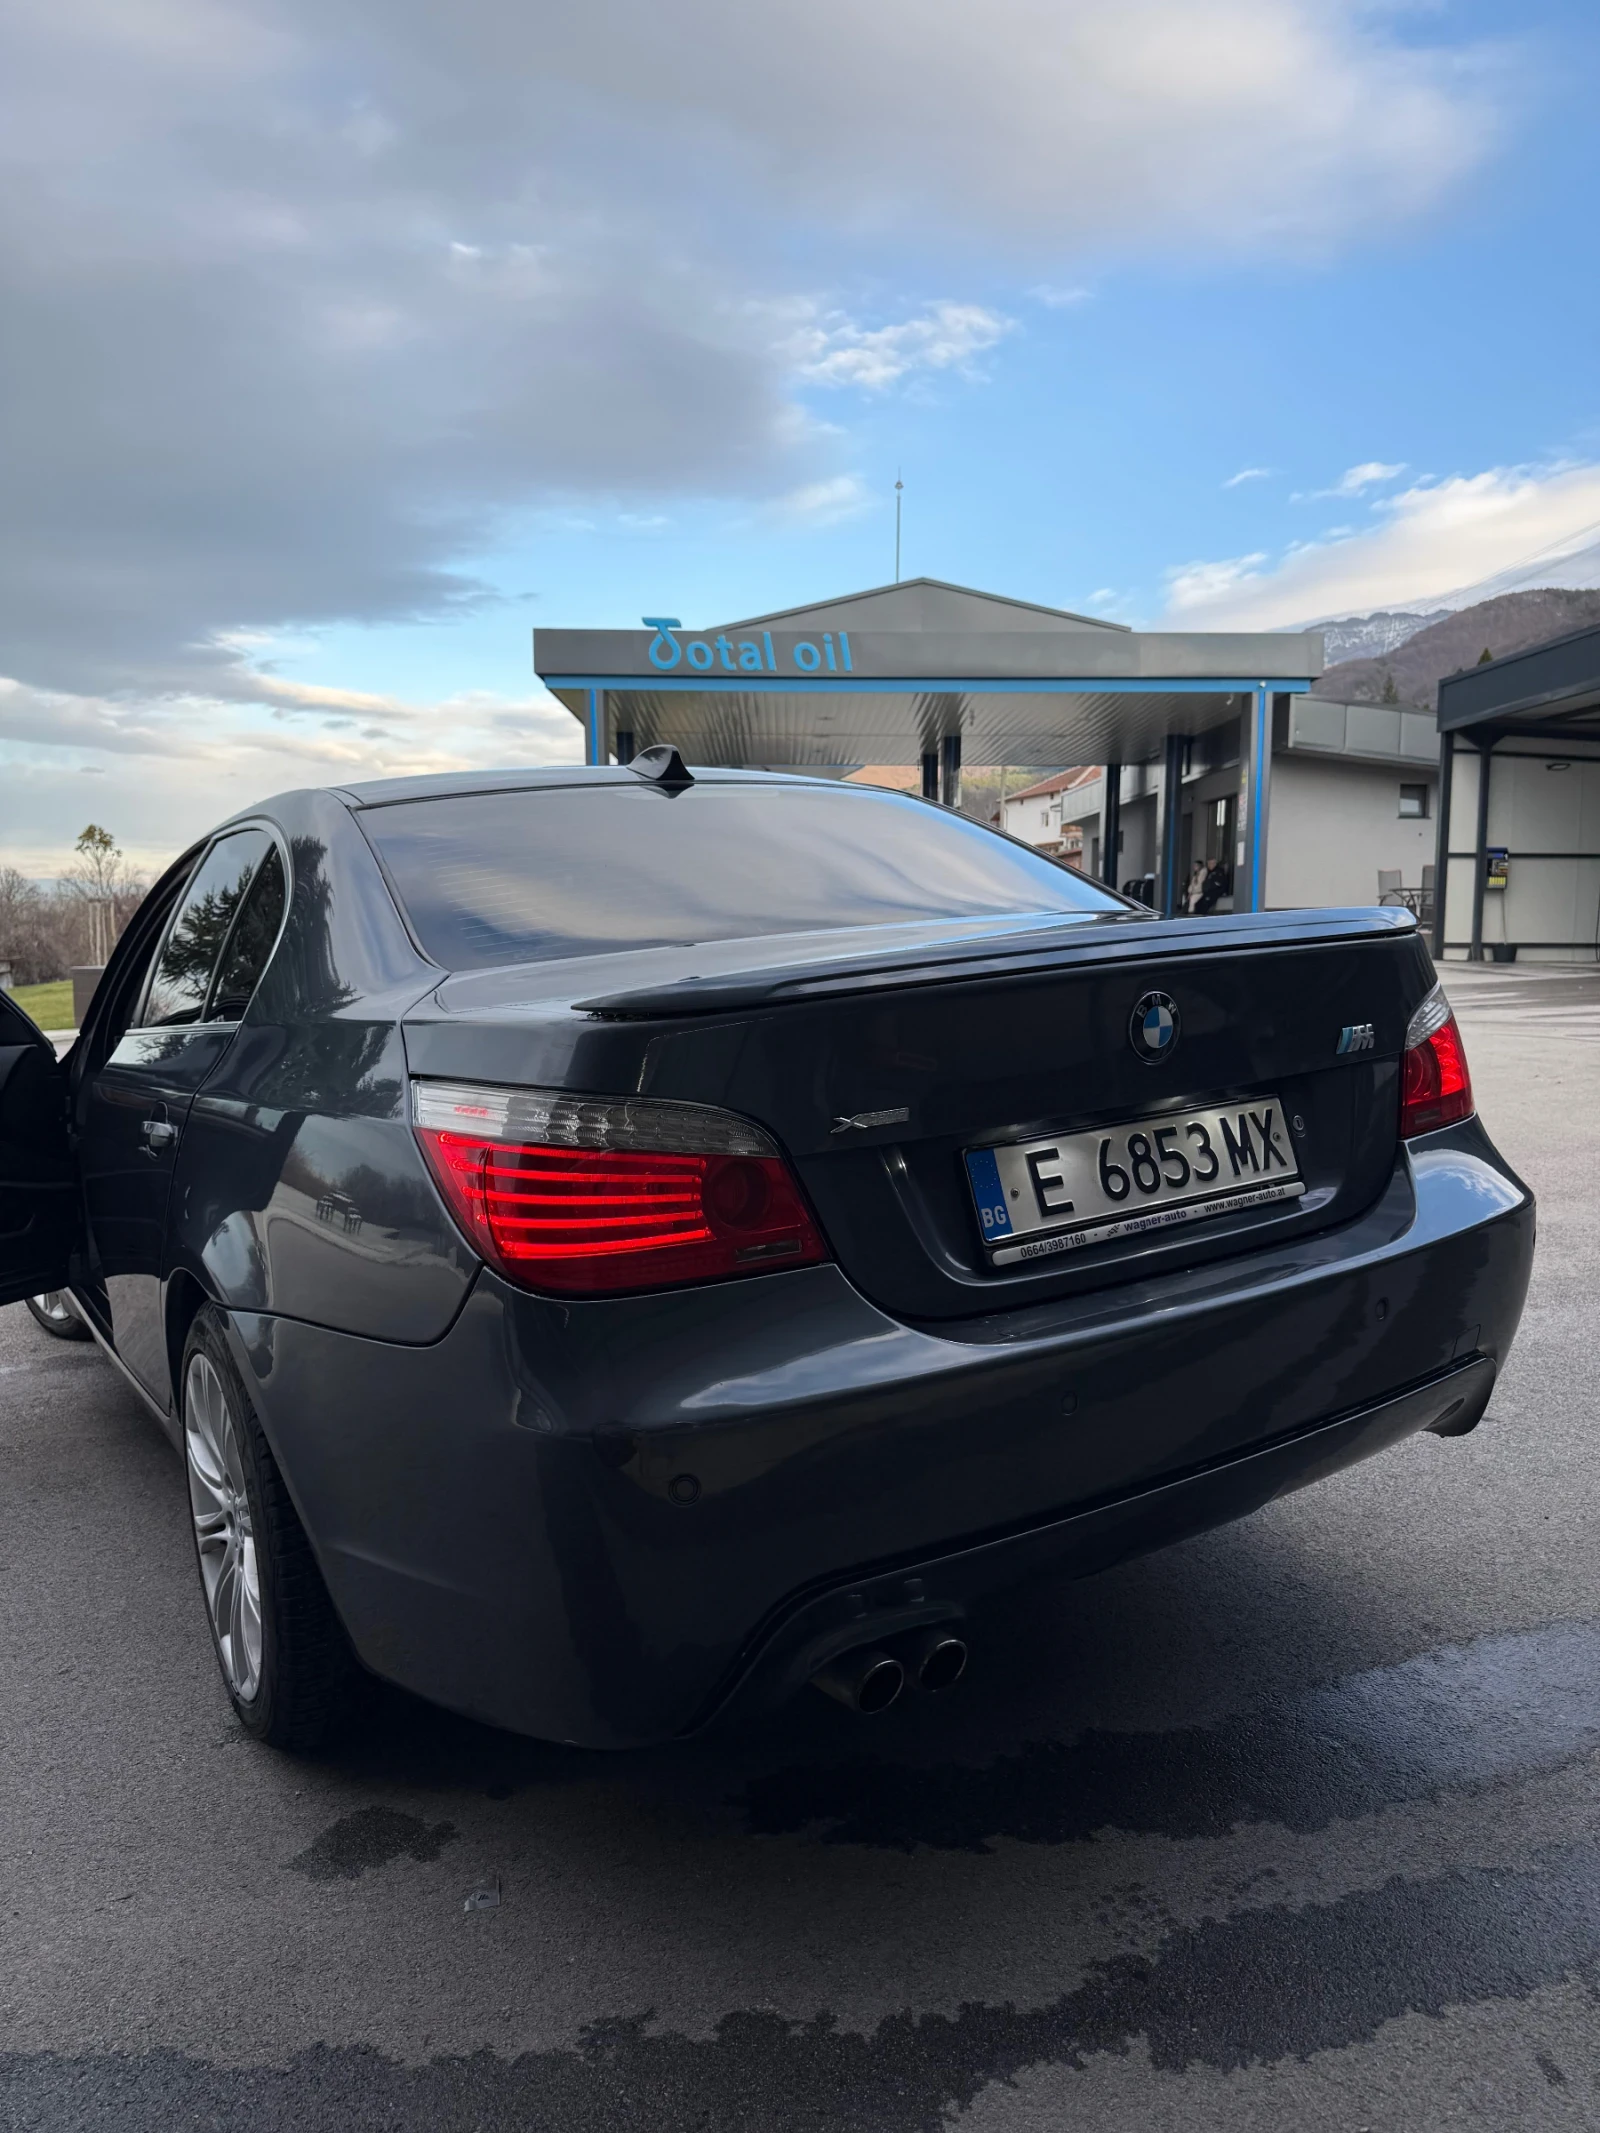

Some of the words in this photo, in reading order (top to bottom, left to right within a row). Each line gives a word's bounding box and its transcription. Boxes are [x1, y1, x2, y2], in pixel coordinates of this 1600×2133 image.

[793, 631, 852, 671] oil
[1136, 993, 1177, 1018] BMW
[1025, 1147, 1075, 1218] E
[1099, 1121, 1220, 1201] 6853
[1219, 1108, 1288, 1176] MX
[980, 1207, 1007, 1229] BG
[1020, 1233, 1087, 1258] 0664/3987160
[1123, 1210, 1188, 1233] wagner-auto
[1204, 1187, 1287, 1213] www.wagner-auto.at
